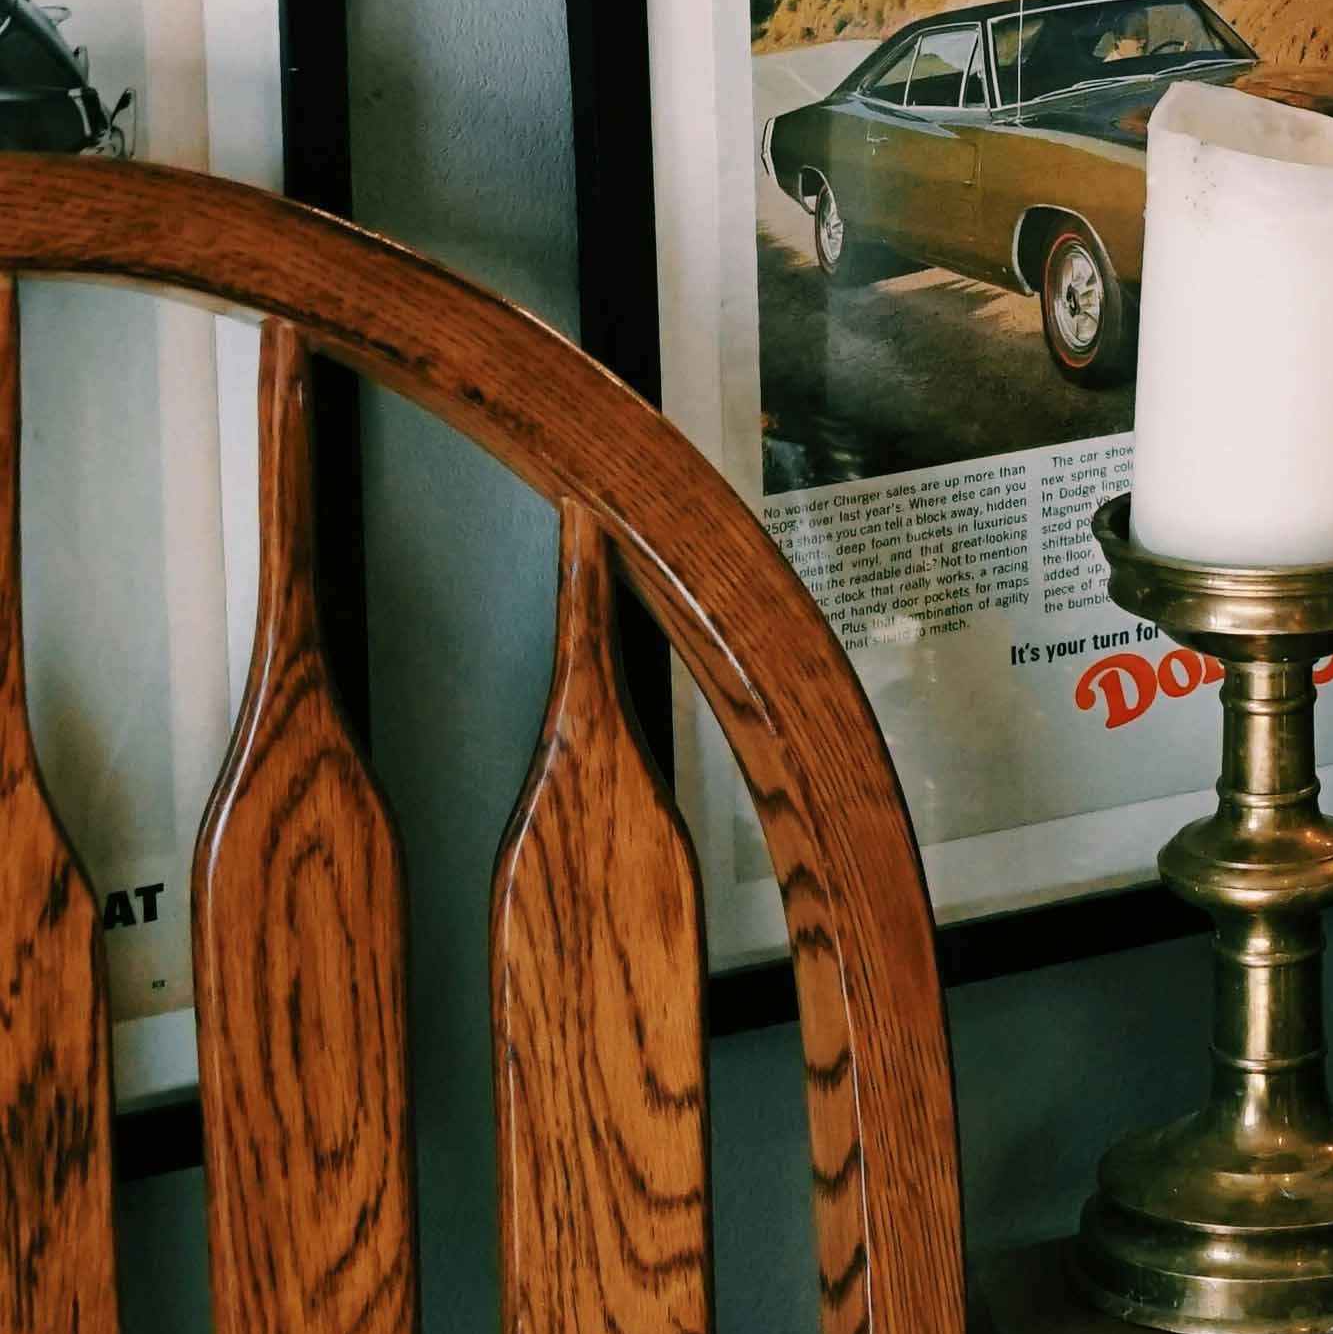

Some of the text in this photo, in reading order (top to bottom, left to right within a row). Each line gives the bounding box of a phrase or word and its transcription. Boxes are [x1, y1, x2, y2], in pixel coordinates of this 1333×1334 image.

[1041, 501, 1092, 518] Magnum
[1011, 642, 1041, 666] It's
[1046, 637, 1086, 663] your
[1093, 629, 1130, 650] turn
